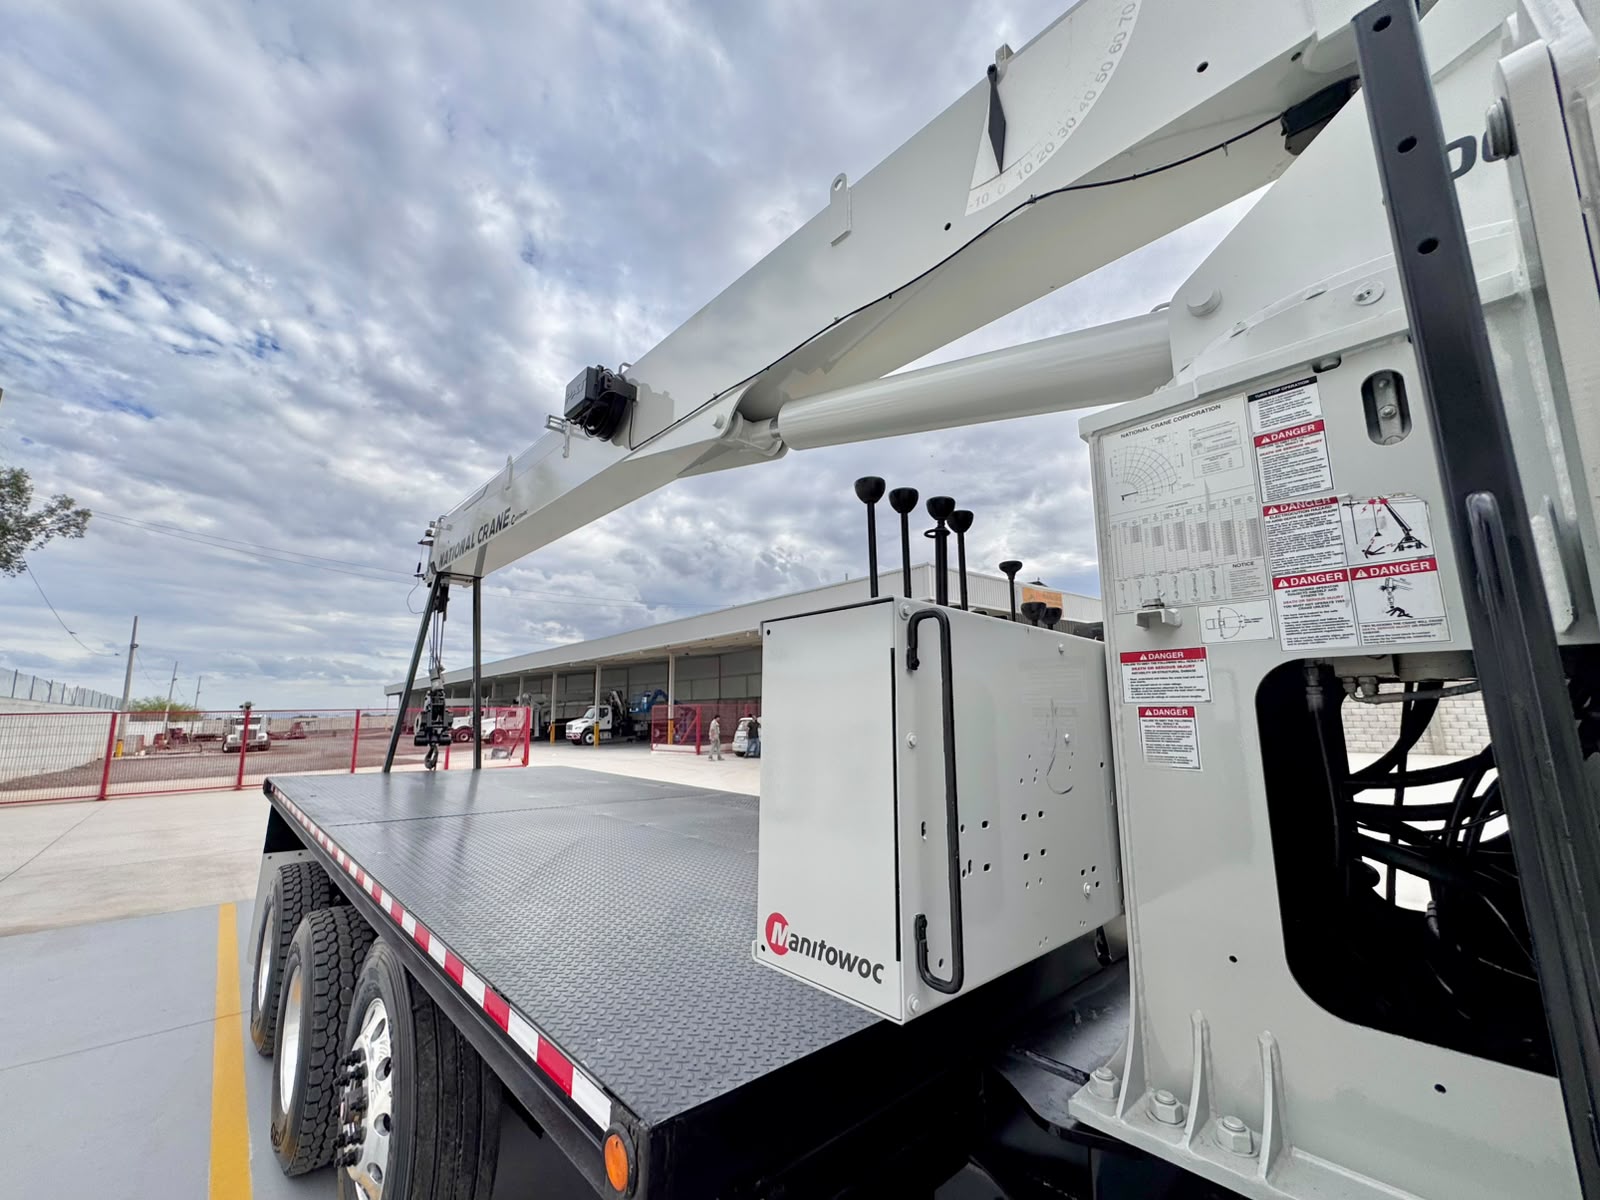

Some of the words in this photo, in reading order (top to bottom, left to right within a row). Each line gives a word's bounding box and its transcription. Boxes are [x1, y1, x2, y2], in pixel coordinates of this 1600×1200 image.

[997, 183, 1006, 194] 0
[1016, 162, 1033, 180] 10
[1036, 142, 1055, 164] 20
[1057, 117, 1077, 139] 30
[1079, 90, 1097, 113] 40
[1095, 62, 1114, 83] 50
[1109, 31, 1127, 55] 60
[1118, 3, 1136, 27] 70
[1281, 380, 1310, 391] OPERATION
[1121, 426, 1149, 439] NATIONAL
[1150, 419, 1172, 430] CRANE
[1172, 404, 1221, 423] CORPORATION
[1271, 424, 1315, 441] DANGER
[1280, 498, 1331, 512] DANGER
[439, 532, 475, 568] NATIONAL
[477, 506, 511, 544] CRANE
[1232, 561, 1255, 569] NOTICE
[1370, 561, 1430, 576] DANGER
[1290, 572, 1343, 586] DANGER
[1148, 651, 1184, 660] DANGER
[766, 914, 884, 985] Manitowoc
